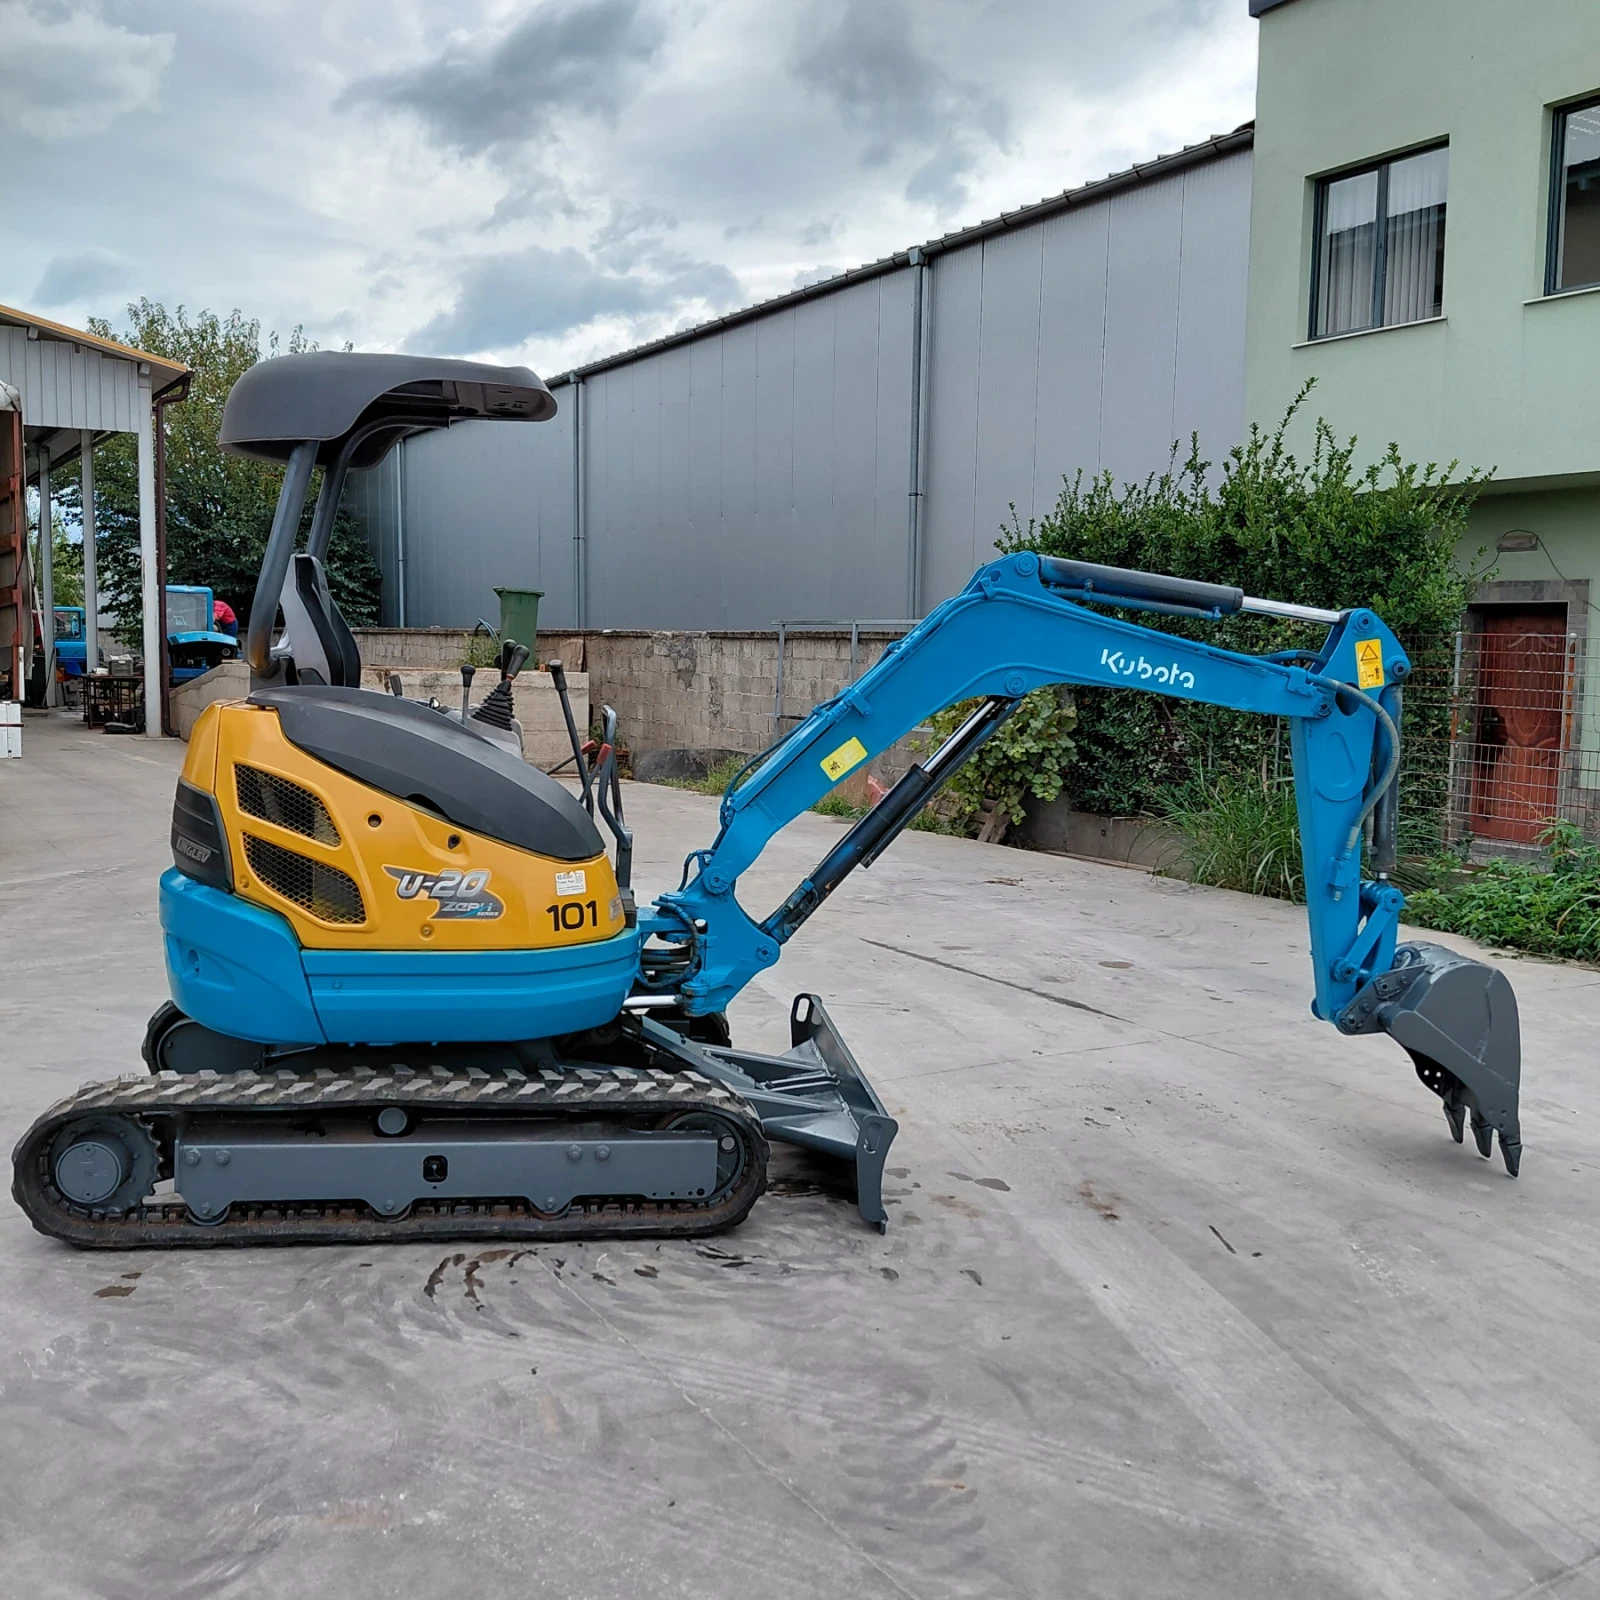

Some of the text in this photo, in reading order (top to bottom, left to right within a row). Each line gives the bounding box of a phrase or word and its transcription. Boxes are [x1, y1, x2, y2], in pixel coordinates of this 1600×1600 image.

[1100, 648, 1195, 689] Kubota
[398, 870, 489, 898] U-20
[546, 900, 598, 932] 101
